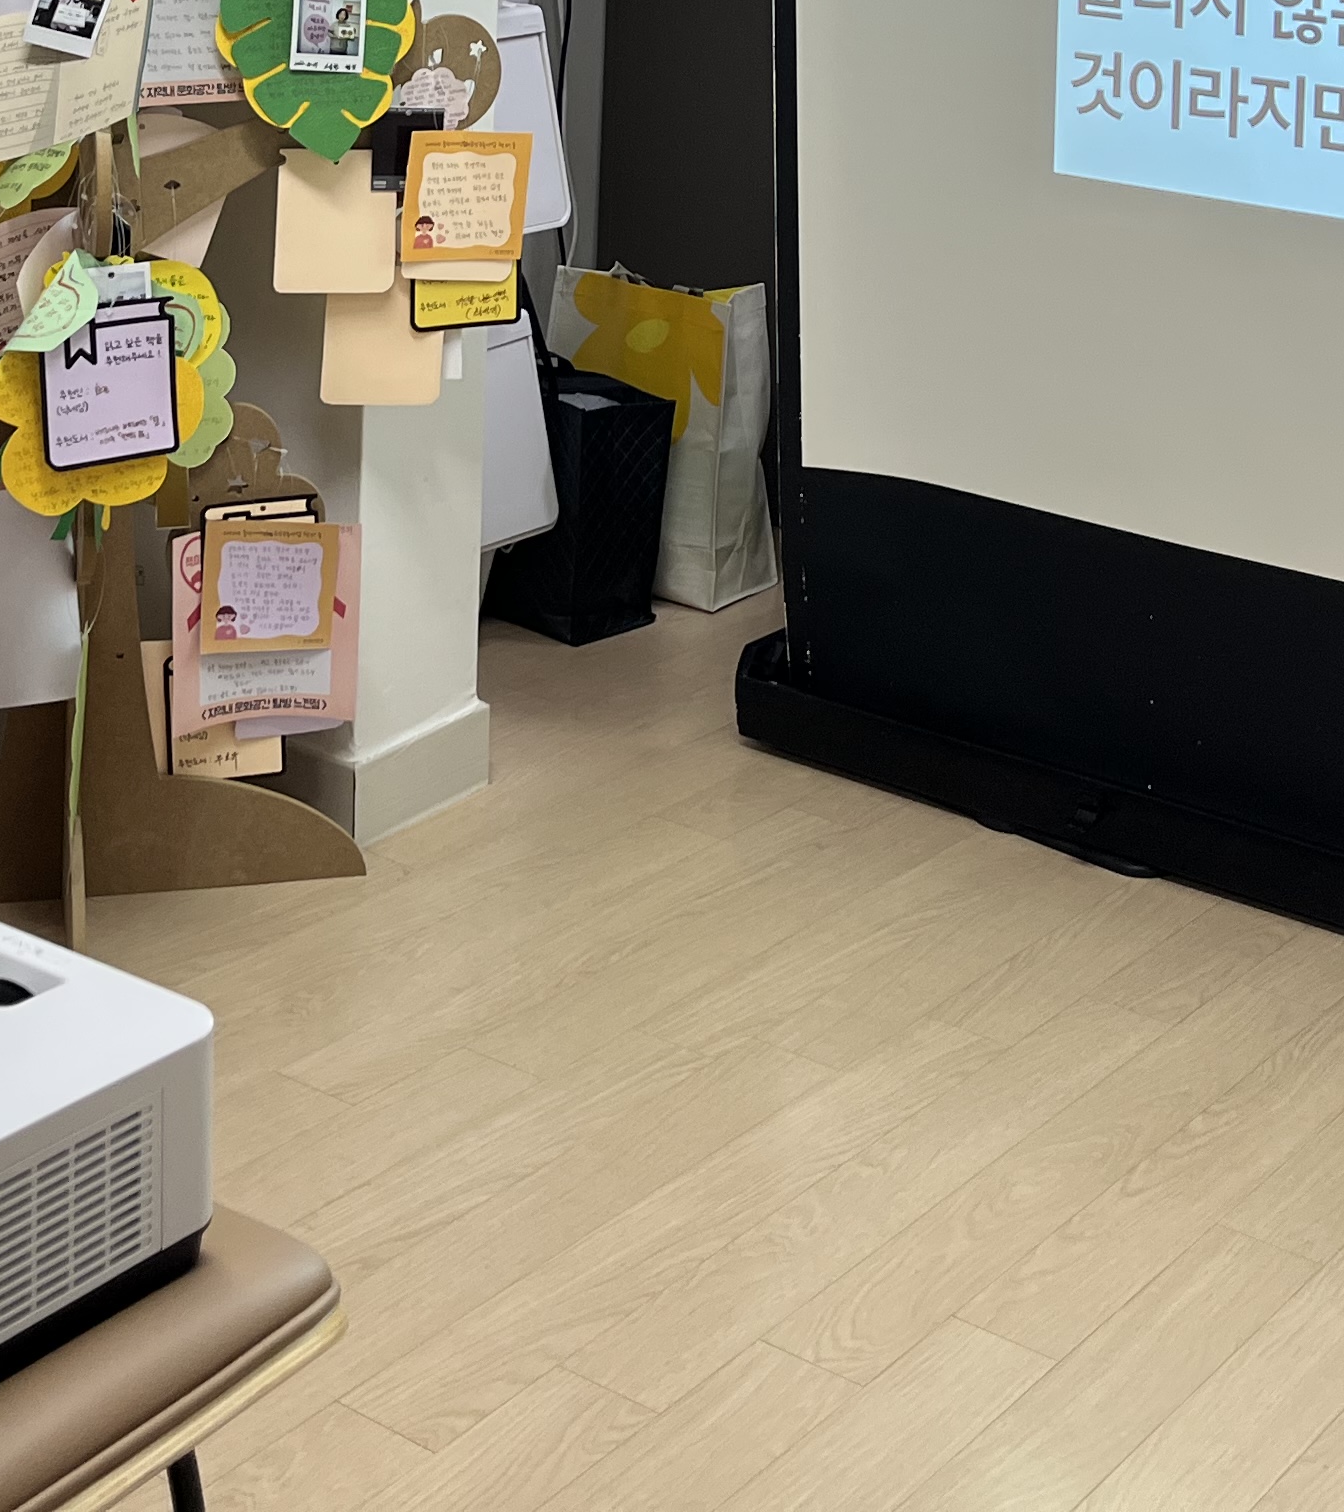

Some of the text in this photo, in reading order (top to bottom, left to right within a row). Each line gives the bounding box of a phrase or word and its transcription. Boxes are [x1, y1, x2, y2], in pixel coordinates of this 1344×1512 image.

[177, 84, 215, 97] 문화공간
[217, 83, 236, 95] 탐방
[235, 700, 270, 713] 문화공간
[273, 698, 291, 710] 탐방
